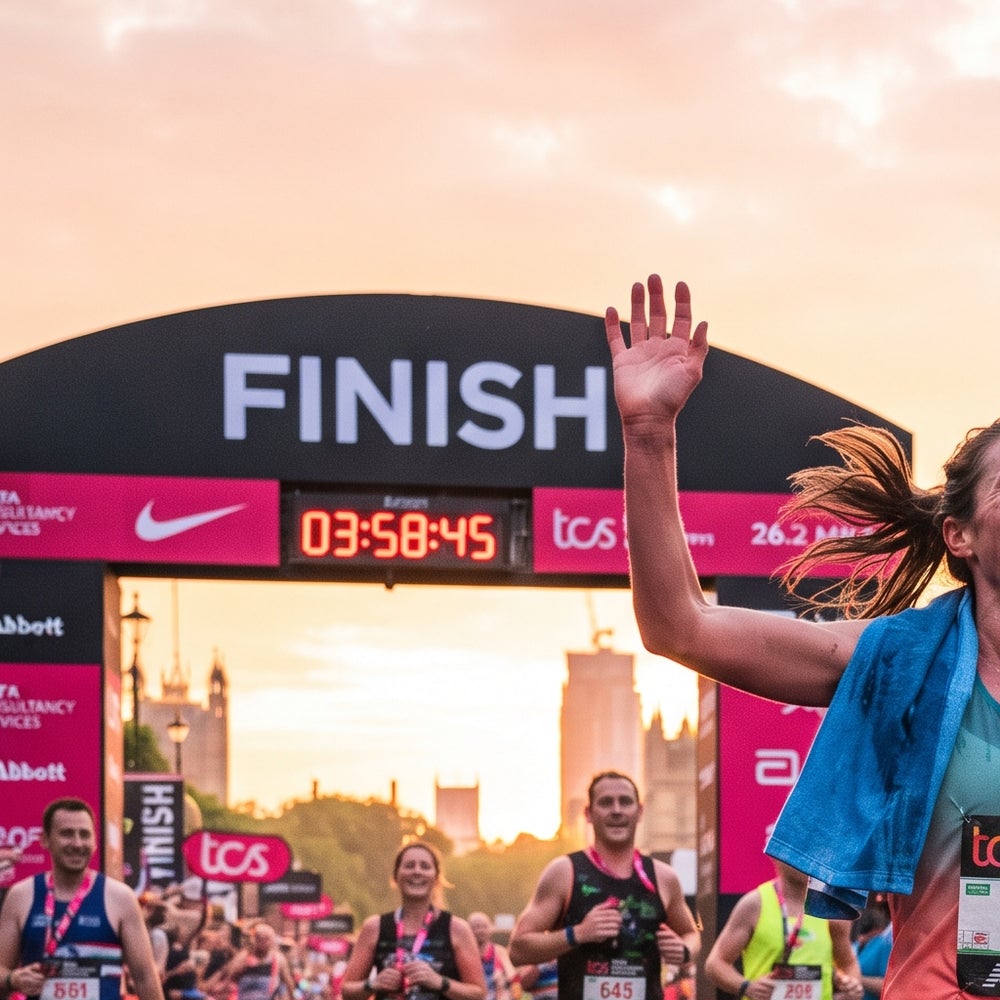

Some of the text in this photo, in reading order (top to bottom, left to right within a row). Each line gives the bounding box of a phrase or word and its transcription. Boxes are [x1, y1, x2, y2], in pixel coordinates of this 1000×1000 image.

[223, 353, 608, 452] FINISH
[301, 510, 497, 561] 03:58:45
[552, 508, 618, 551] tcs
[750, 521, 808, 546] 26.2
[201, 831, 270, 877] tcs
[600, 981, 633, 1000] 645
